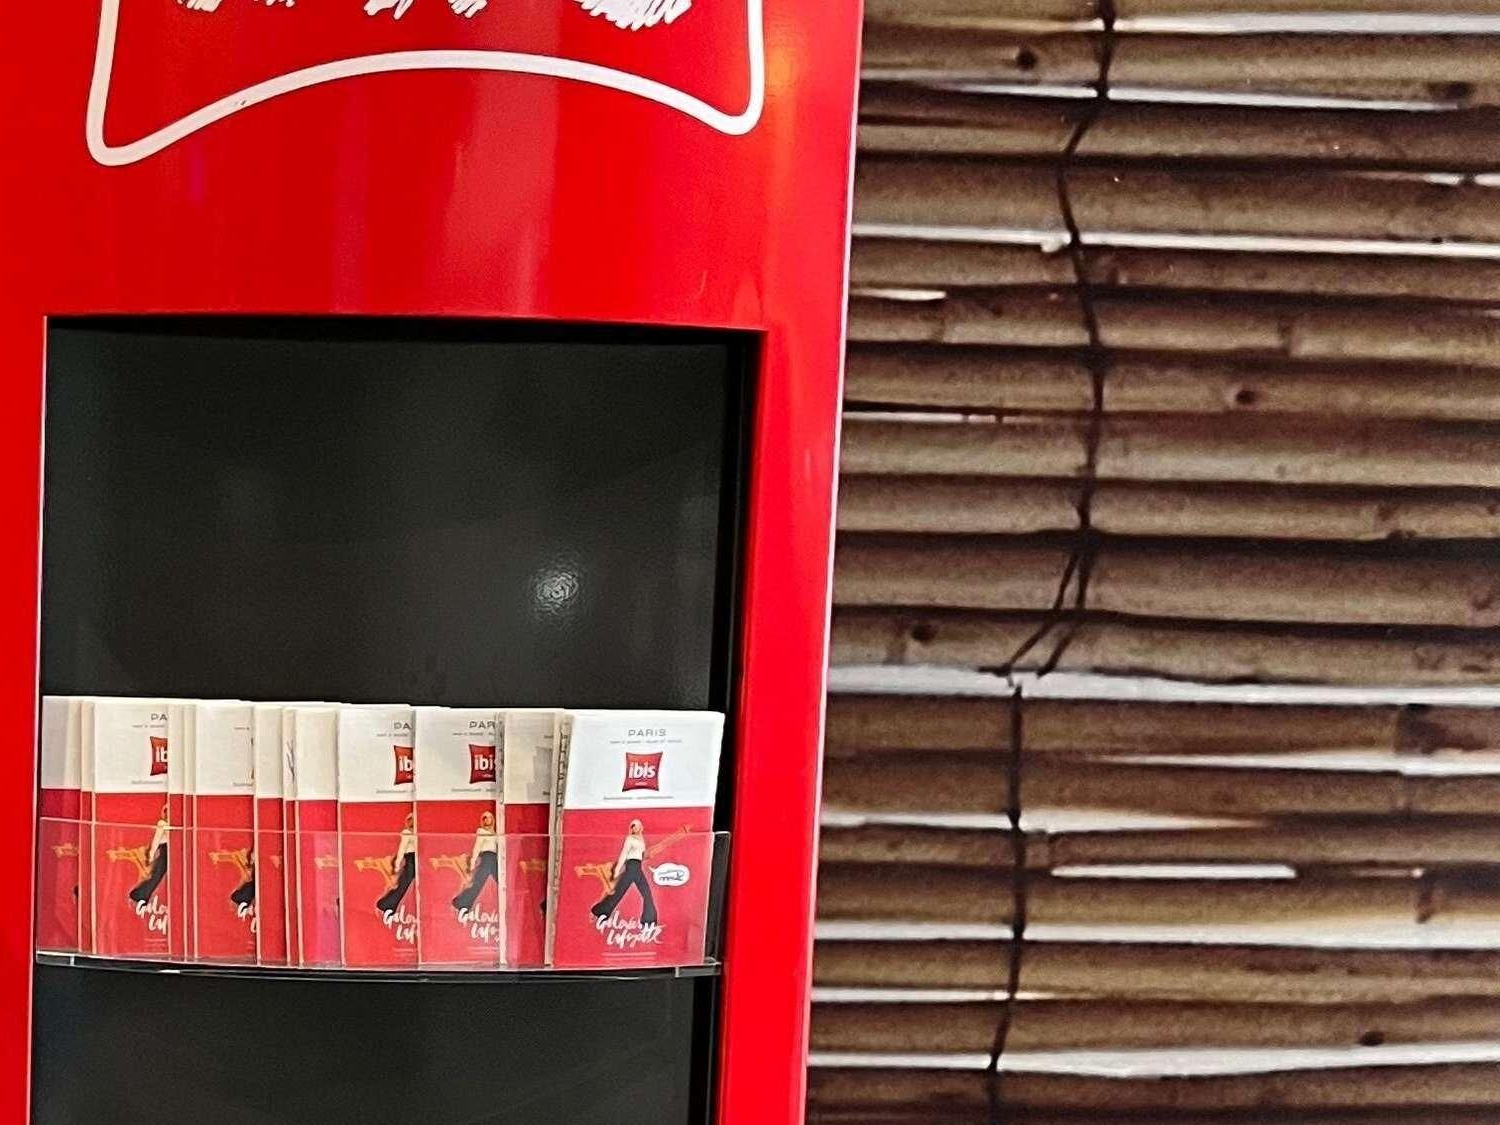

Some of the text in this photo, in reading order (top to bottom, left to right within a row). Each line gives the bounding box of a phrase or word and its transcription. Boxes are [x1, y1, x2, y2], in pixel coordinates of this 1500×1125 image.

[628, 728, 668, 738] PARIS
[474, 754, 496, 771] ibi
[628, 761, 657, 779] ibis
